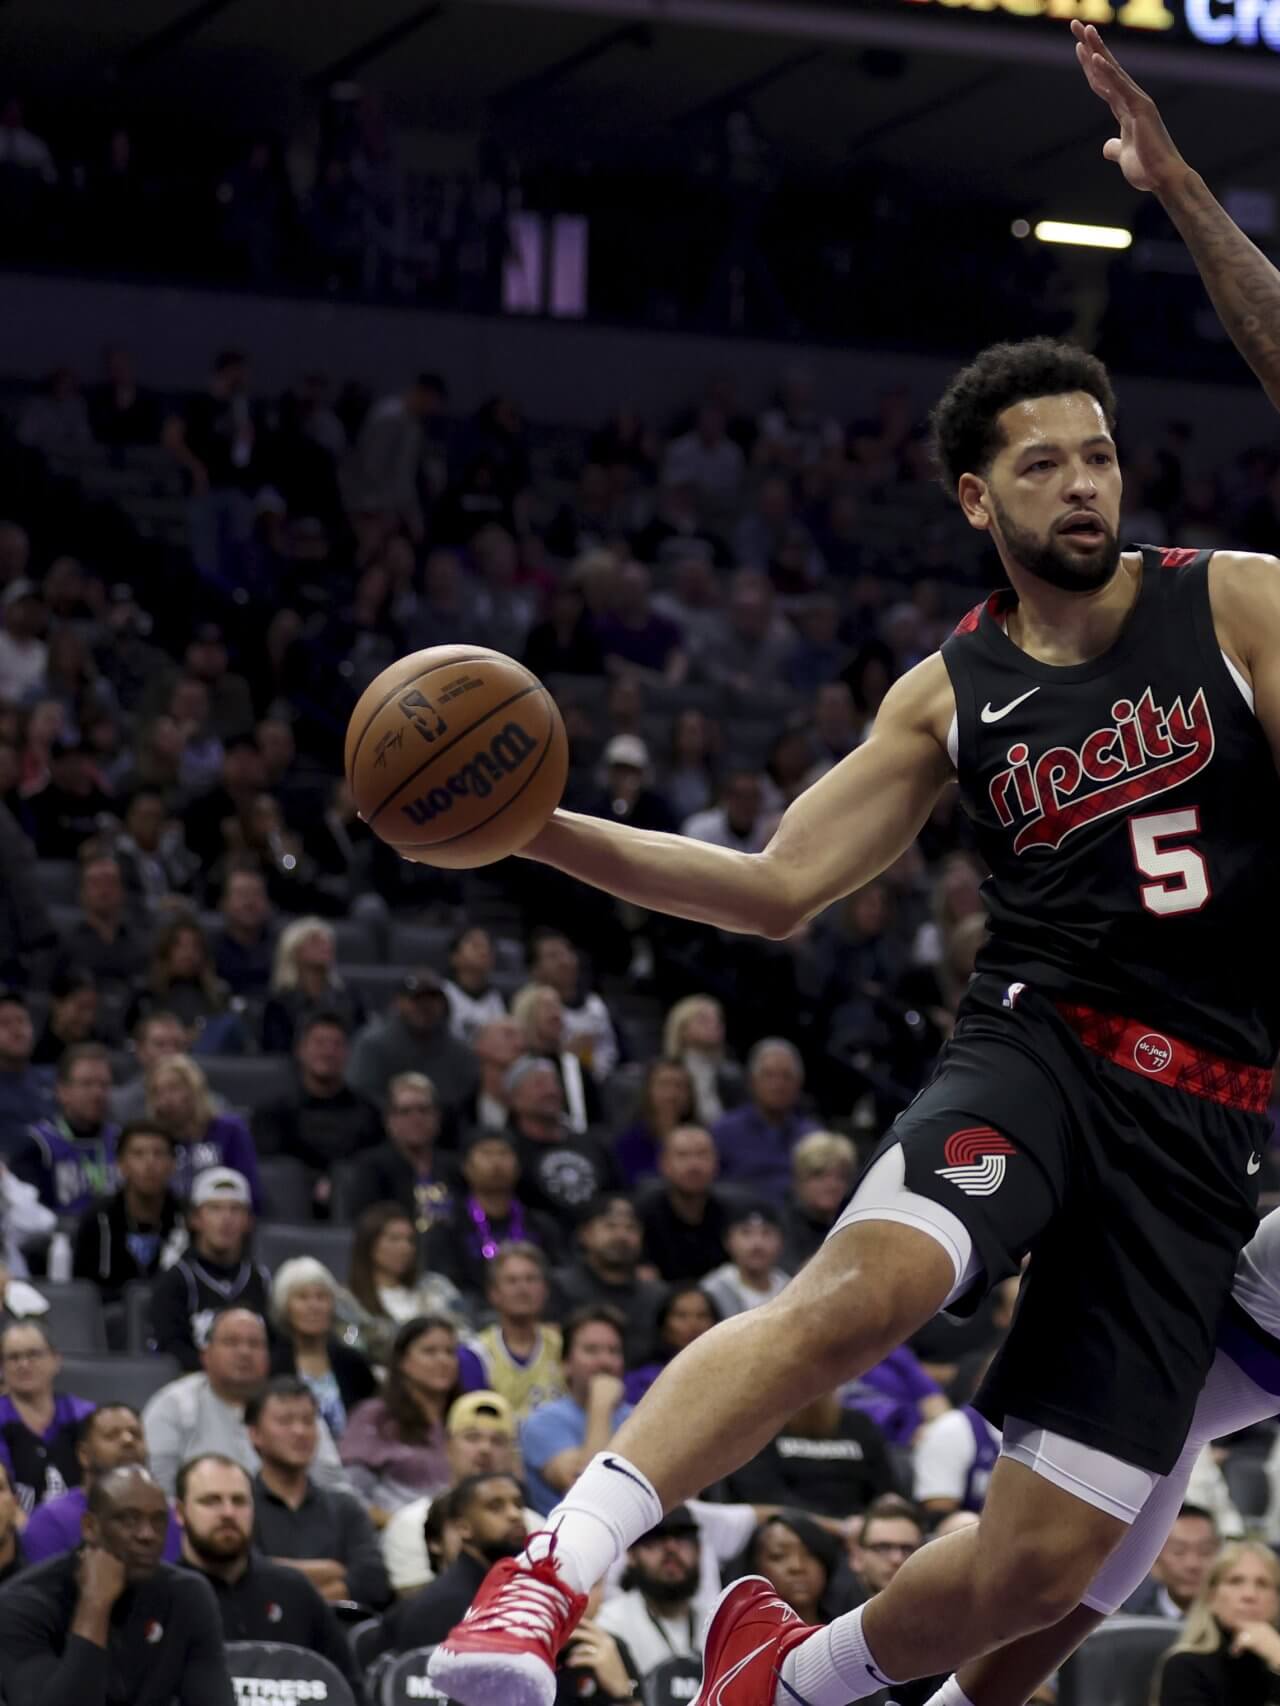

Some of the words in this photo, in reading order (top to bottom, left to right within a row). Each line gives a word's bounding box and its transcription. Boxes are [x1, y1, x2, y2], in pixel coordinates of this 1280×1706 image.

[400, 721, 538, 827] Wilson
[1128, 804, 1213, 918] 5
[1152, 1056, 1165, 1067] 77
